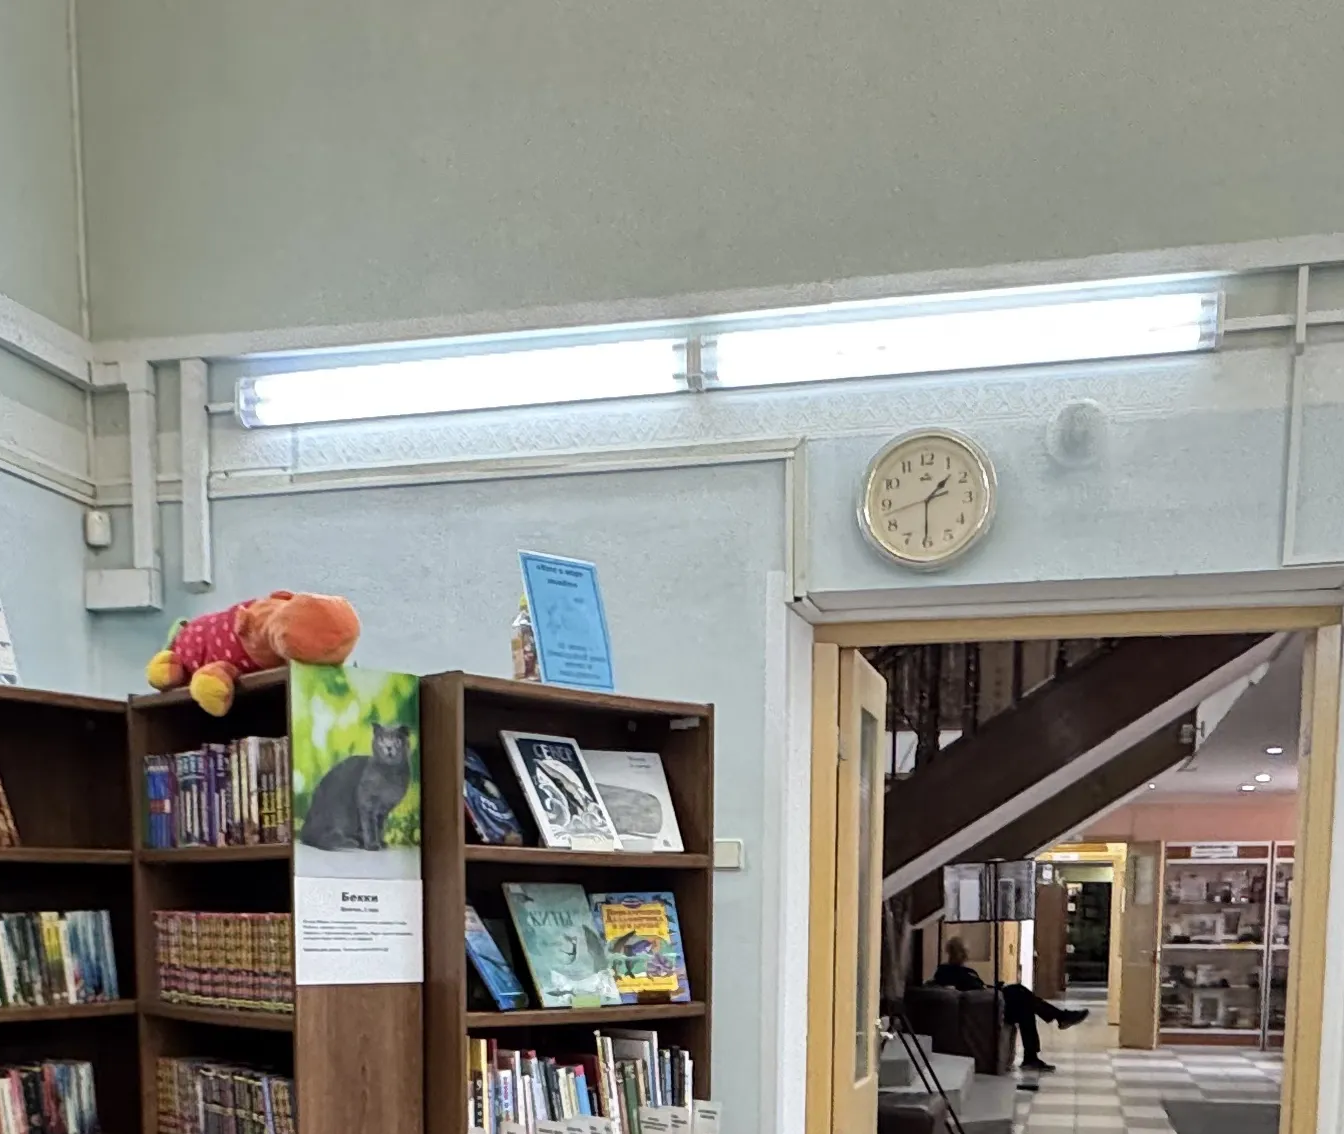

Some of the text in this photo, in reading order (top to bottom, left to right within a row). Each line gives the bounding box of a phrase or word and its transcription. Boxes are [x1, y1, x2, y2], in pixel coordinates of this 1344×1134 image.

[920, 452, 935, 466] 12
[901, 461, 912, 474] 11
[958, 471, 968, 484] 2
[885, 478, 900, 490] 10
[962, 491, 973, 503] 3
[881, 500, 892, 511] 9
[956, 512, 965, 525] 4
[887, 519, 898, 531] 8
[902, 532, 912, 545] 7
[943, 530, 954, 541] 5
[922, 536, 933, 548] 6
[341, 892, 379, 902] Бекки
